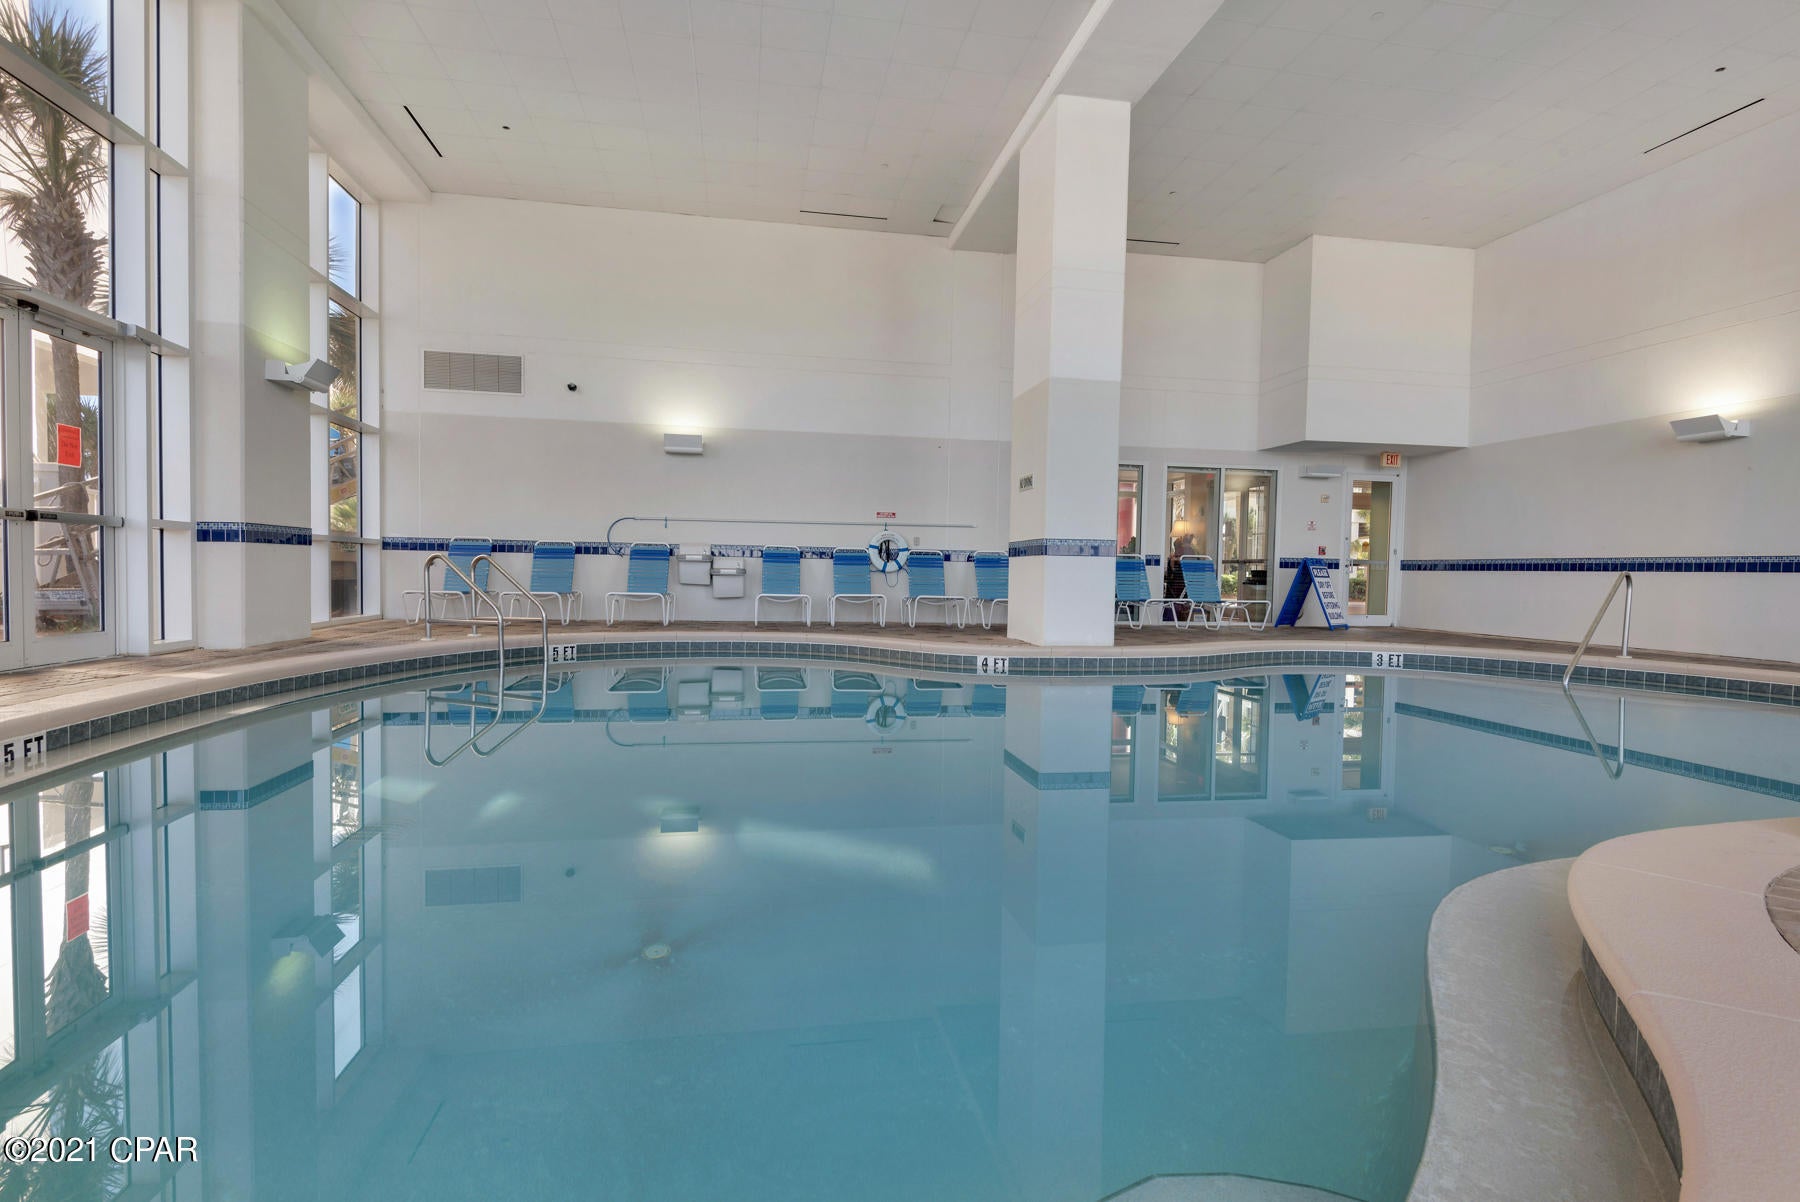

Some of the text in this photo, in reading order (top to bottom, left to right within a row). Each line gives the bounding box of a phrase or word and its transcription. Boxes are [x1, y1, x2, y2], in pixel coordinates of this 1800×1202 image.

[1386, 454, 1399, 466] EXIT
[3, 735, 44, 763] 5 FT
